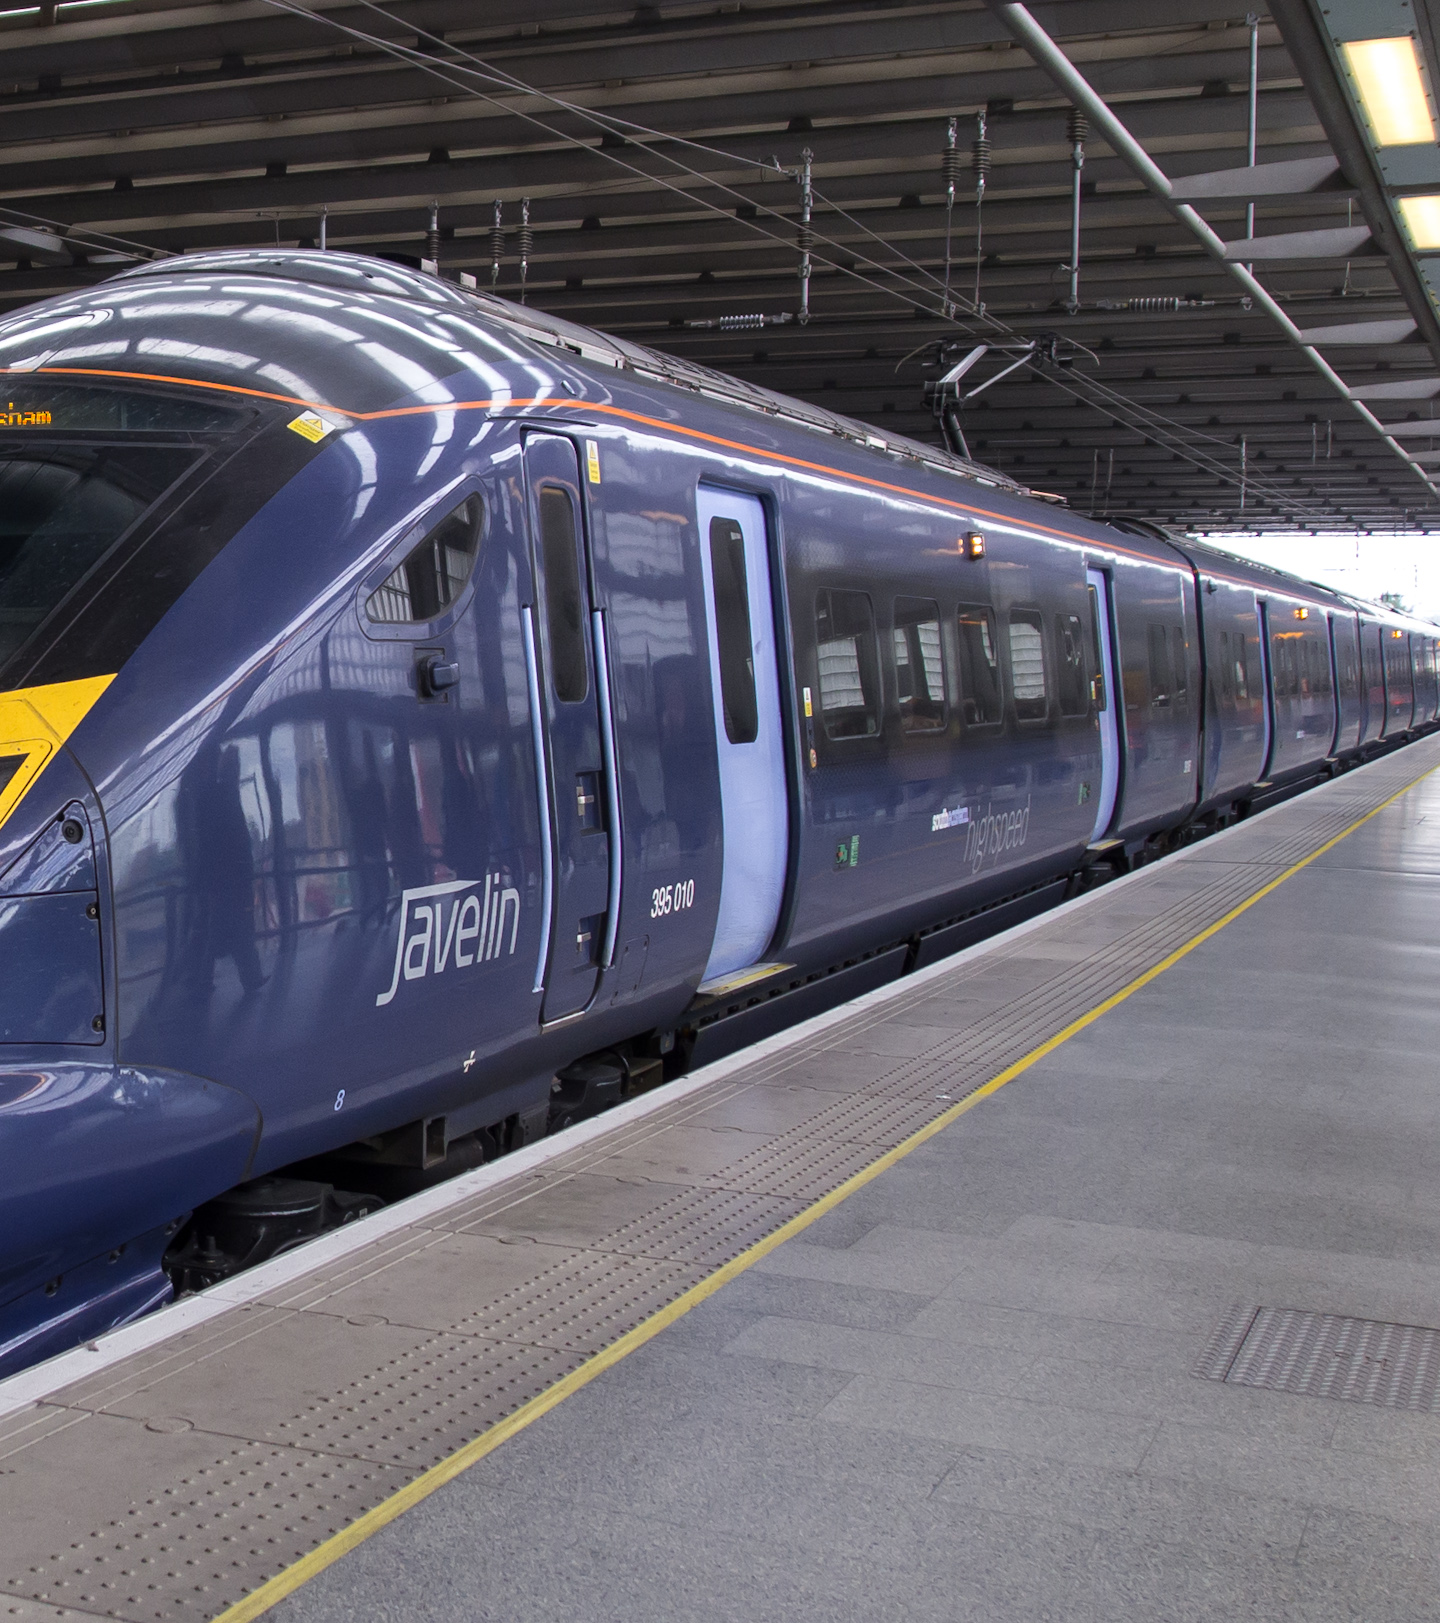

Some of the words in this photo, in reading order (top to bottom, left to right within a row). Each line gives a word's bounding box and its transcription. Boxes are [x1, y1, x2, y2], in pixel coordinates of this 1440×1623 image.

[963, 793, 1031, 875] highspeed
[650, 885, 673, 919] 395
[674, 879, 695, 912] 010
[376, 872, 520, 1007] Javelin
[334, 1088, 346, 1111] 8
